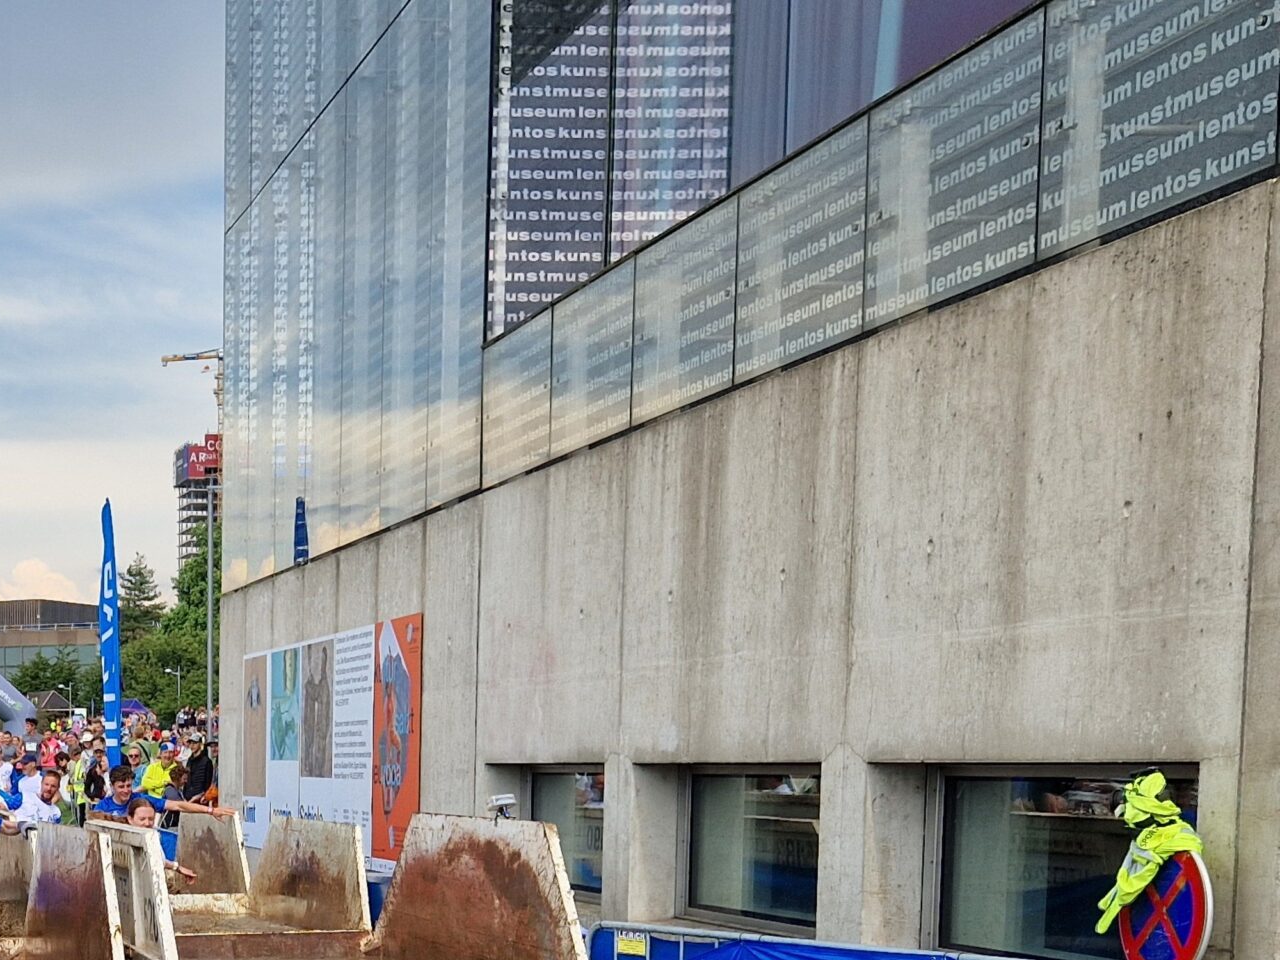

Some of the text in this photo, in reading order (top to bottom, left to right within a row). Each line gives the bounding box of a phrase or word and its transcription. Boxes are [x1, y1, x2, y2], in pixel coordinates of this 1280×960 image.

[561, 64, 608, 77] kuns
[1135, 42, 1208, 94] lentos
[983, 92, 1041, 134] lentos
[1198, 91, 1279, 144] lentos
[492, 126, 607, 139] lntos kuns
[933, 155, 987, 195] lentos
[1040, 130, 1277, 250] museum lentos kunst
[557, 188, 604, 200] kuns
[823, 185, 866, 220] lentos
[979, 201, 1038, 242] lentos
[555, 249, 602, 262] kuns
[787, 237, 828, 268] lentos
[488, 270, 596, 282] kunstmus
[865, 234, 1036, 323] museum lentos kunst
[821, 280, 864, 311] lentos
[734, 307, 863, 376] museum lentos kunst
